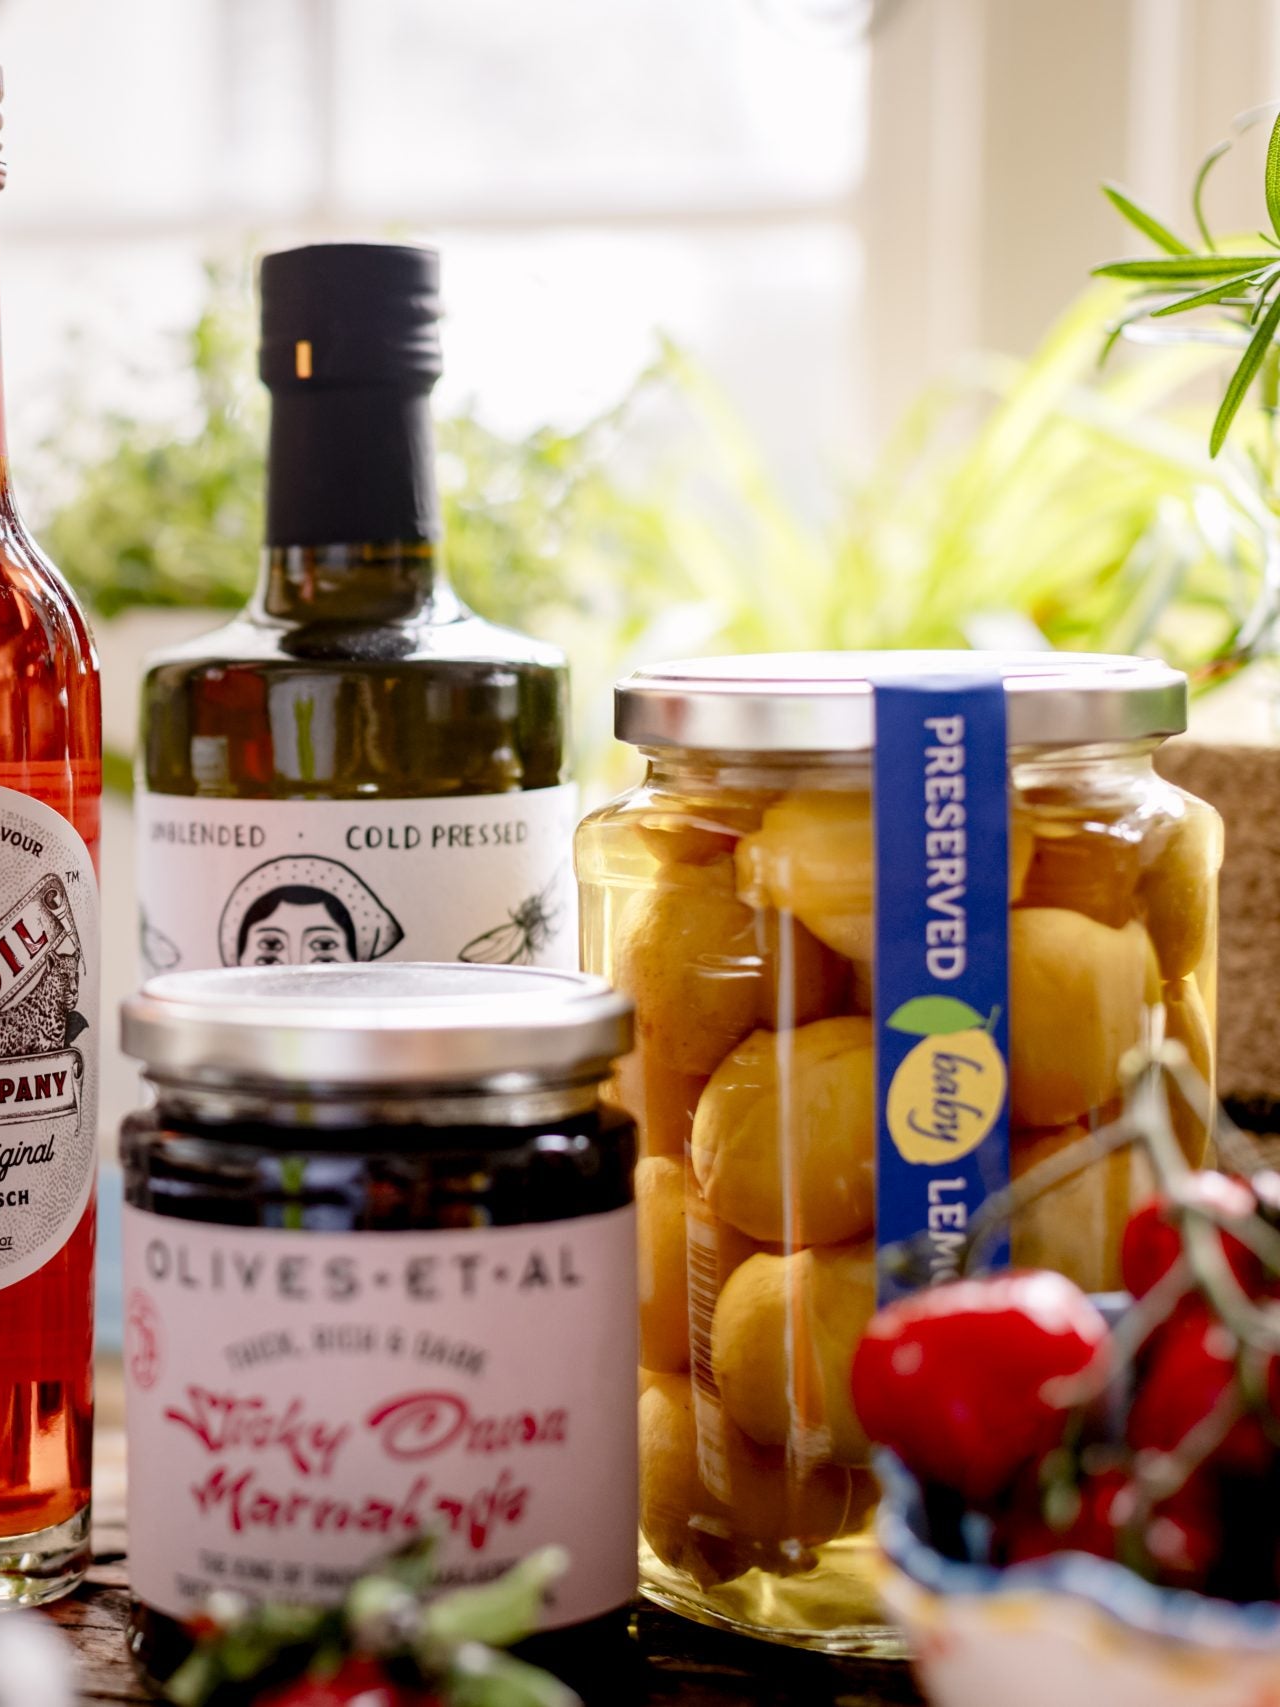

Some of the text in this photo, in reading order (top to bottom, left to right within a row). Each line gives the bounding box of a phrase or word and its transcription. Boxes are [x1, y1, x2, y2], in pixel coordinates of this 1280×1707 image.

[346, 820, 527, 850] COLD PRESSED
[923, 714, 967, 981] PRESERVED
[907, 1050, 984, 1145] baby
